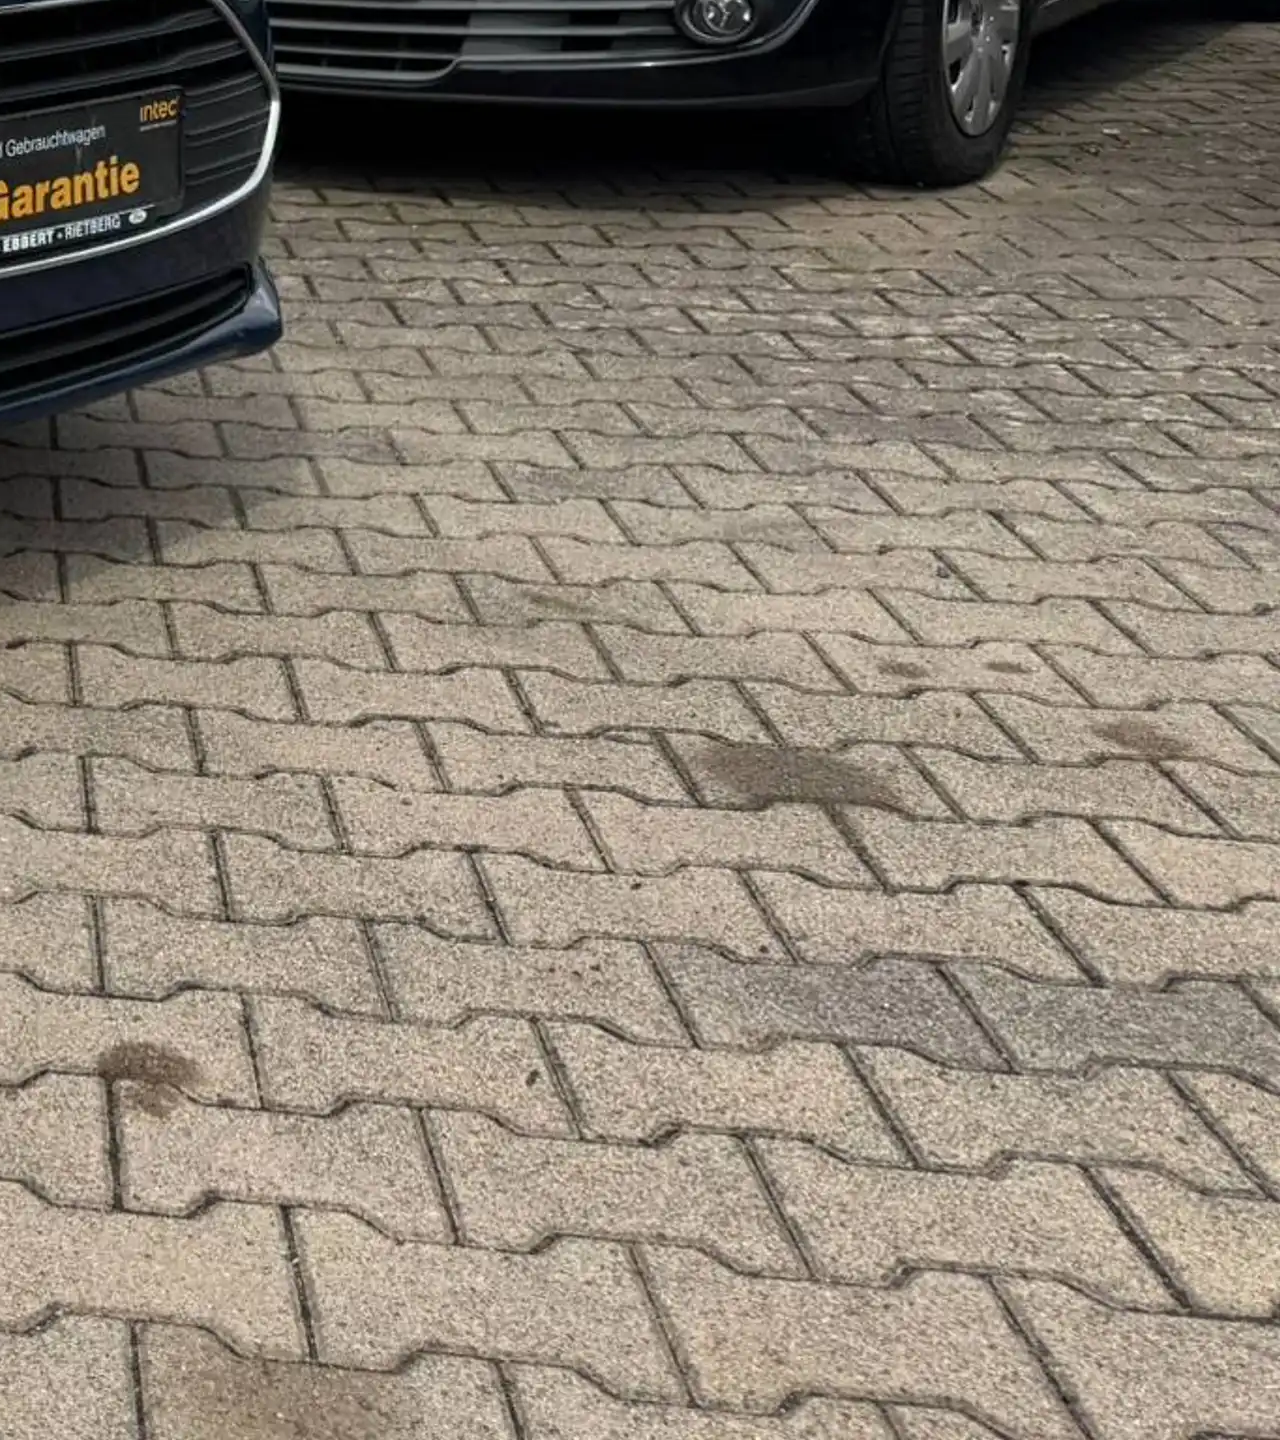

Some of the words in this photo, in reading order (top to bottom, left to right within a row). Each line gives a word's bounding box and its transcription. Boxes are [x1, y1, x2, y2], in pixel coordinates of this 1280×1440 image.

[5, 124, 107, 157] Gebrauchtwagen
[2, 228, 55, 253] EBBERT
[64, 212, 122, 240] RIETBERG
